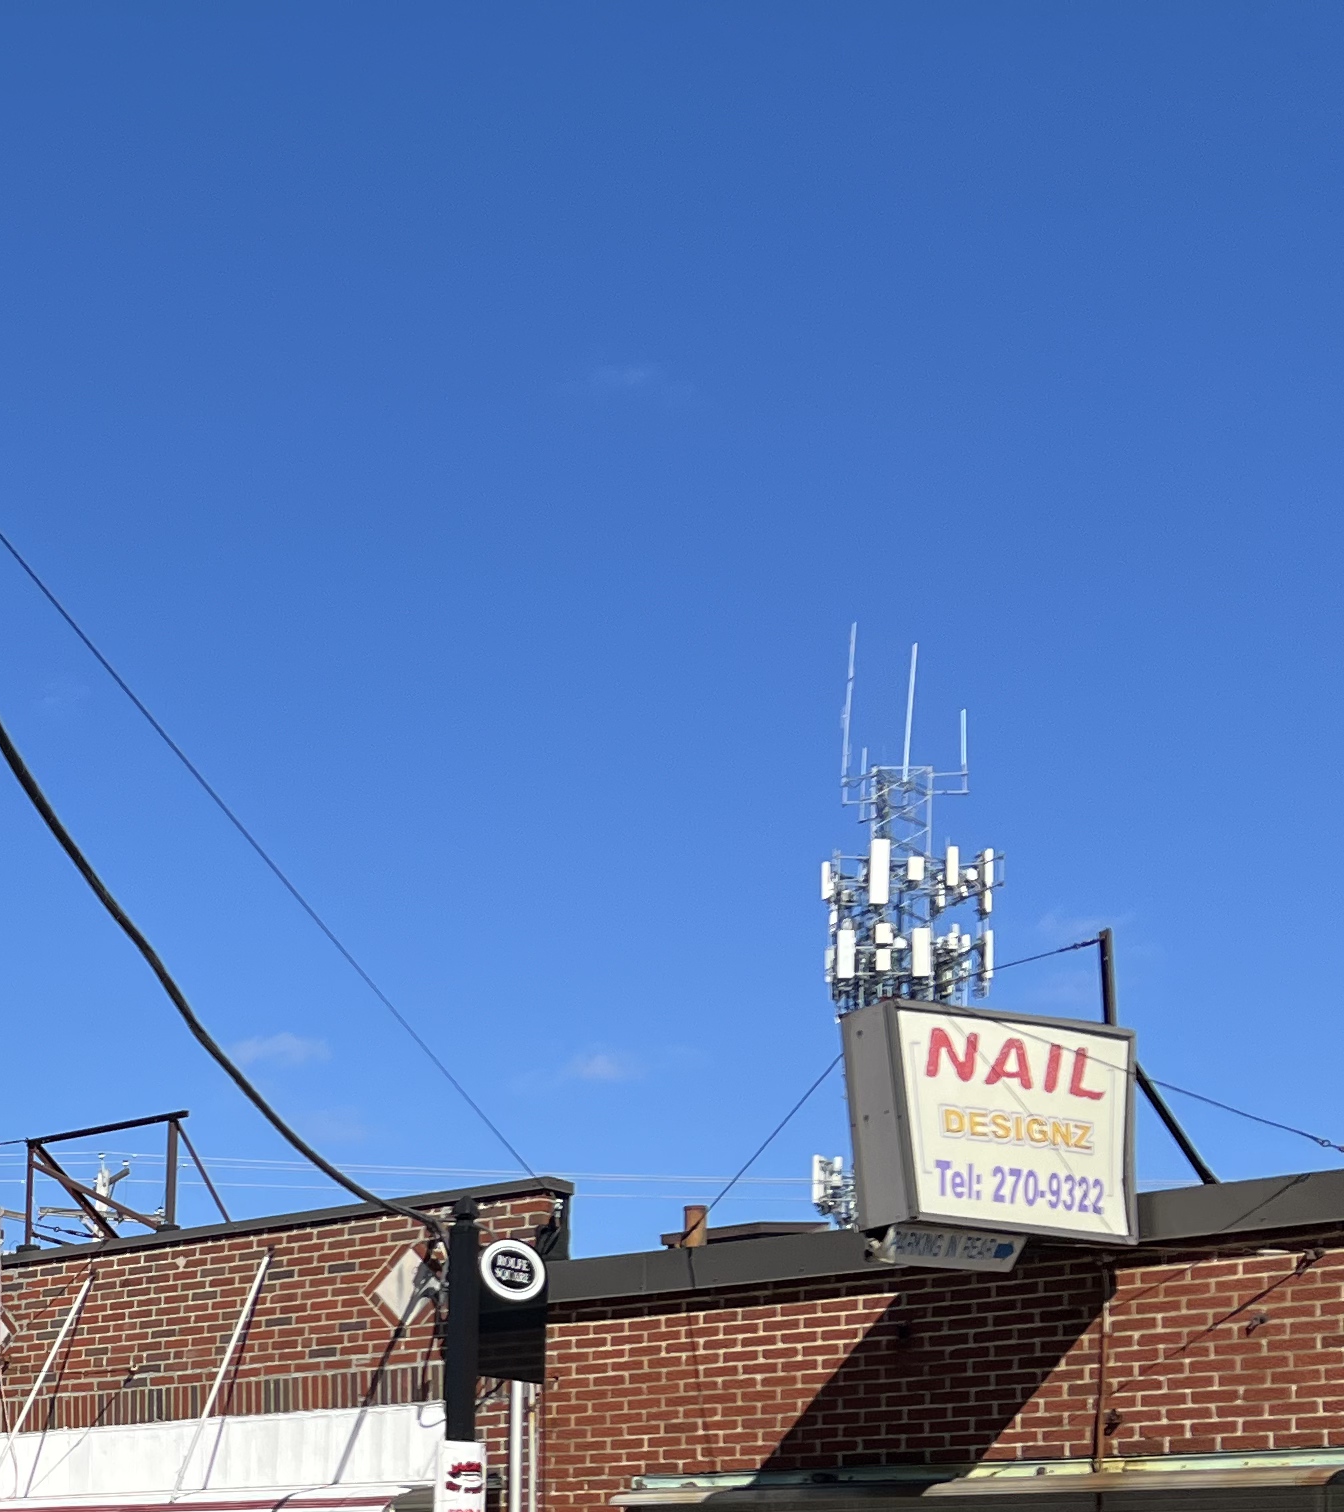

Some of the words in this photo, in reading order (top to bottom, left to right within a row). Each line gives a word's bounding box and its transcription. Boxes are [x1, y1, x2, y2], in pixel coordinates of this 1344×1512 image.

[925, 1027, 1107, 1100] NAIL
[943, 1108, 1093, 1150] DESIGNZ
[935, 1159, 982, 1201] Tel:
[992, 1165, 1104, 1215] 270-9322
